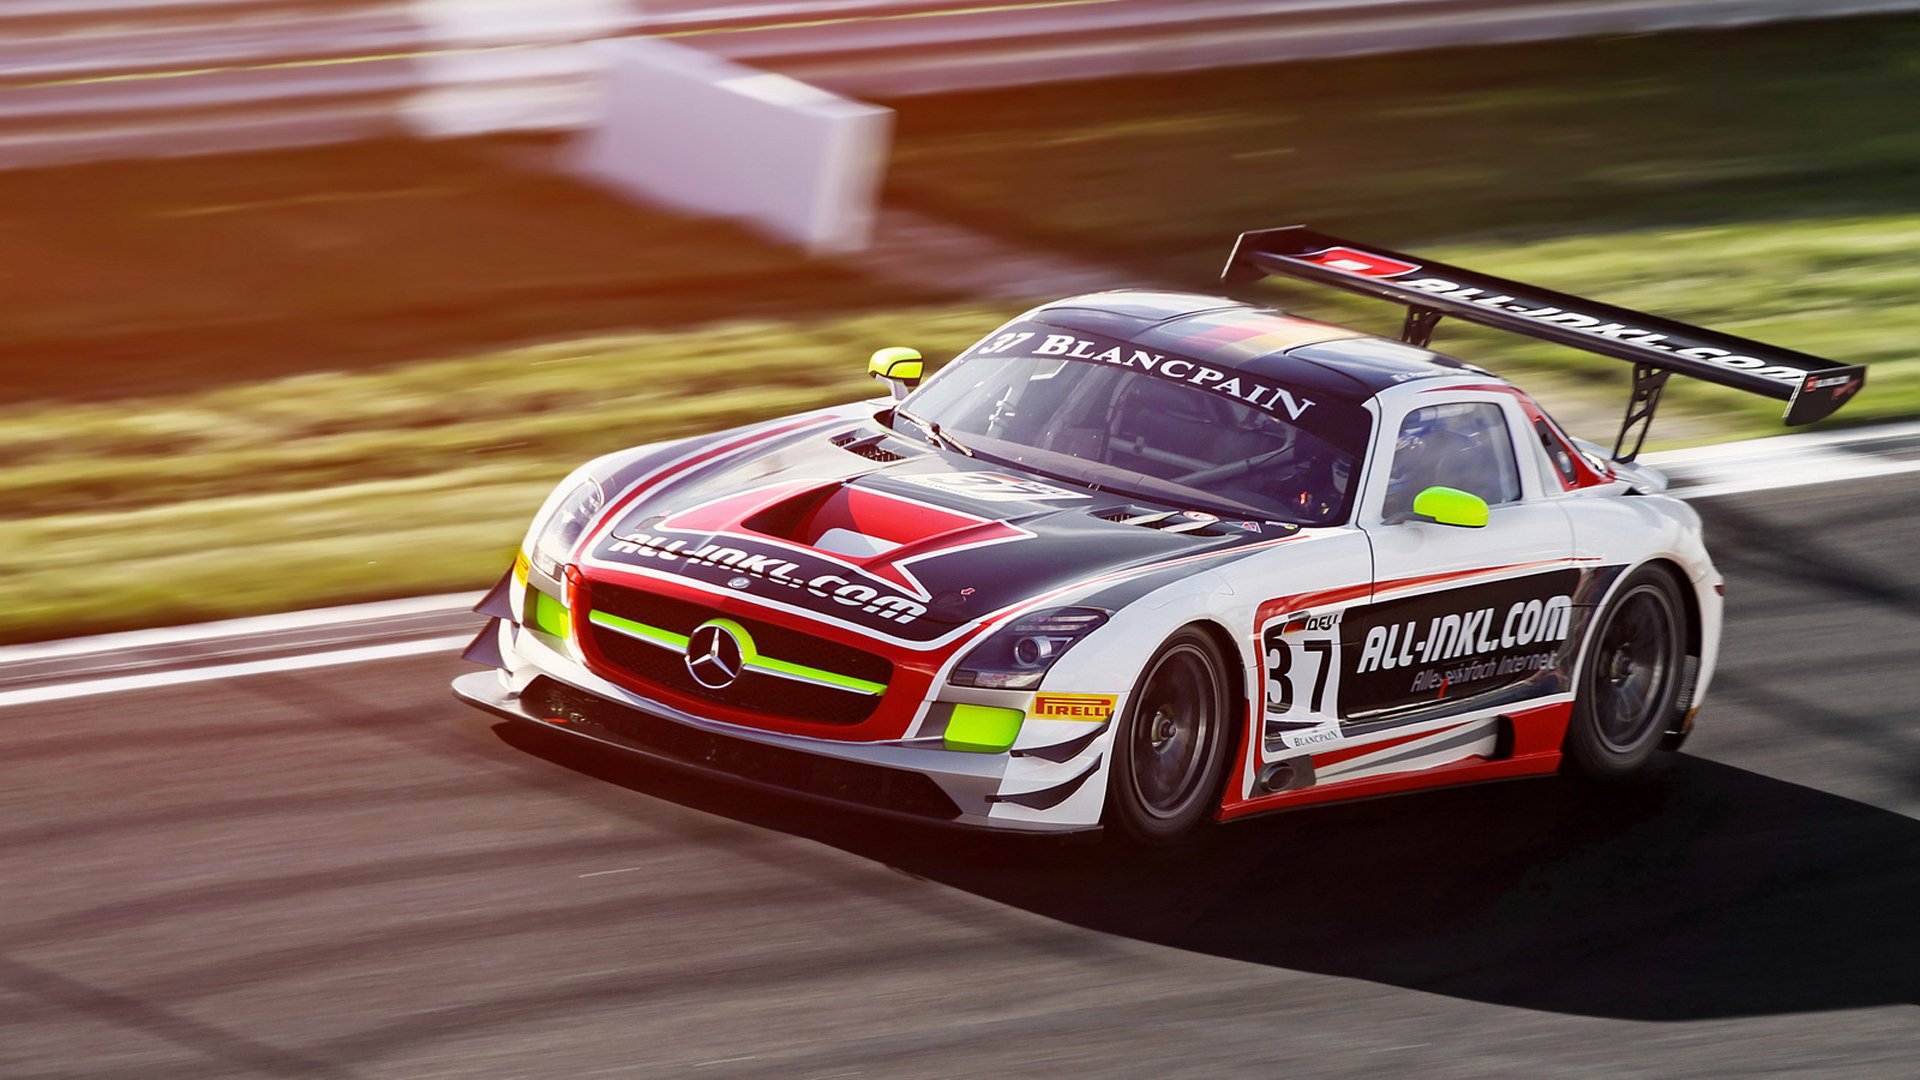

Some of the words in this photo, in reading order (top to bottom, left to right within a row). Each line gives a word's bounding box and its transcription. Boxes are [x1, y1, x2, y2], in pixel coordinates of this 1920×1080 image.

[979, 332, 1035, 355] 37
[1032, 334, 1316, 421] BLANCPAIN
[1356, 595, 1573, 674] ALL-INKL.COM
[1035, 697, 1111, 717] PIRELLI
[1265, 636, 1333, 714] 37
